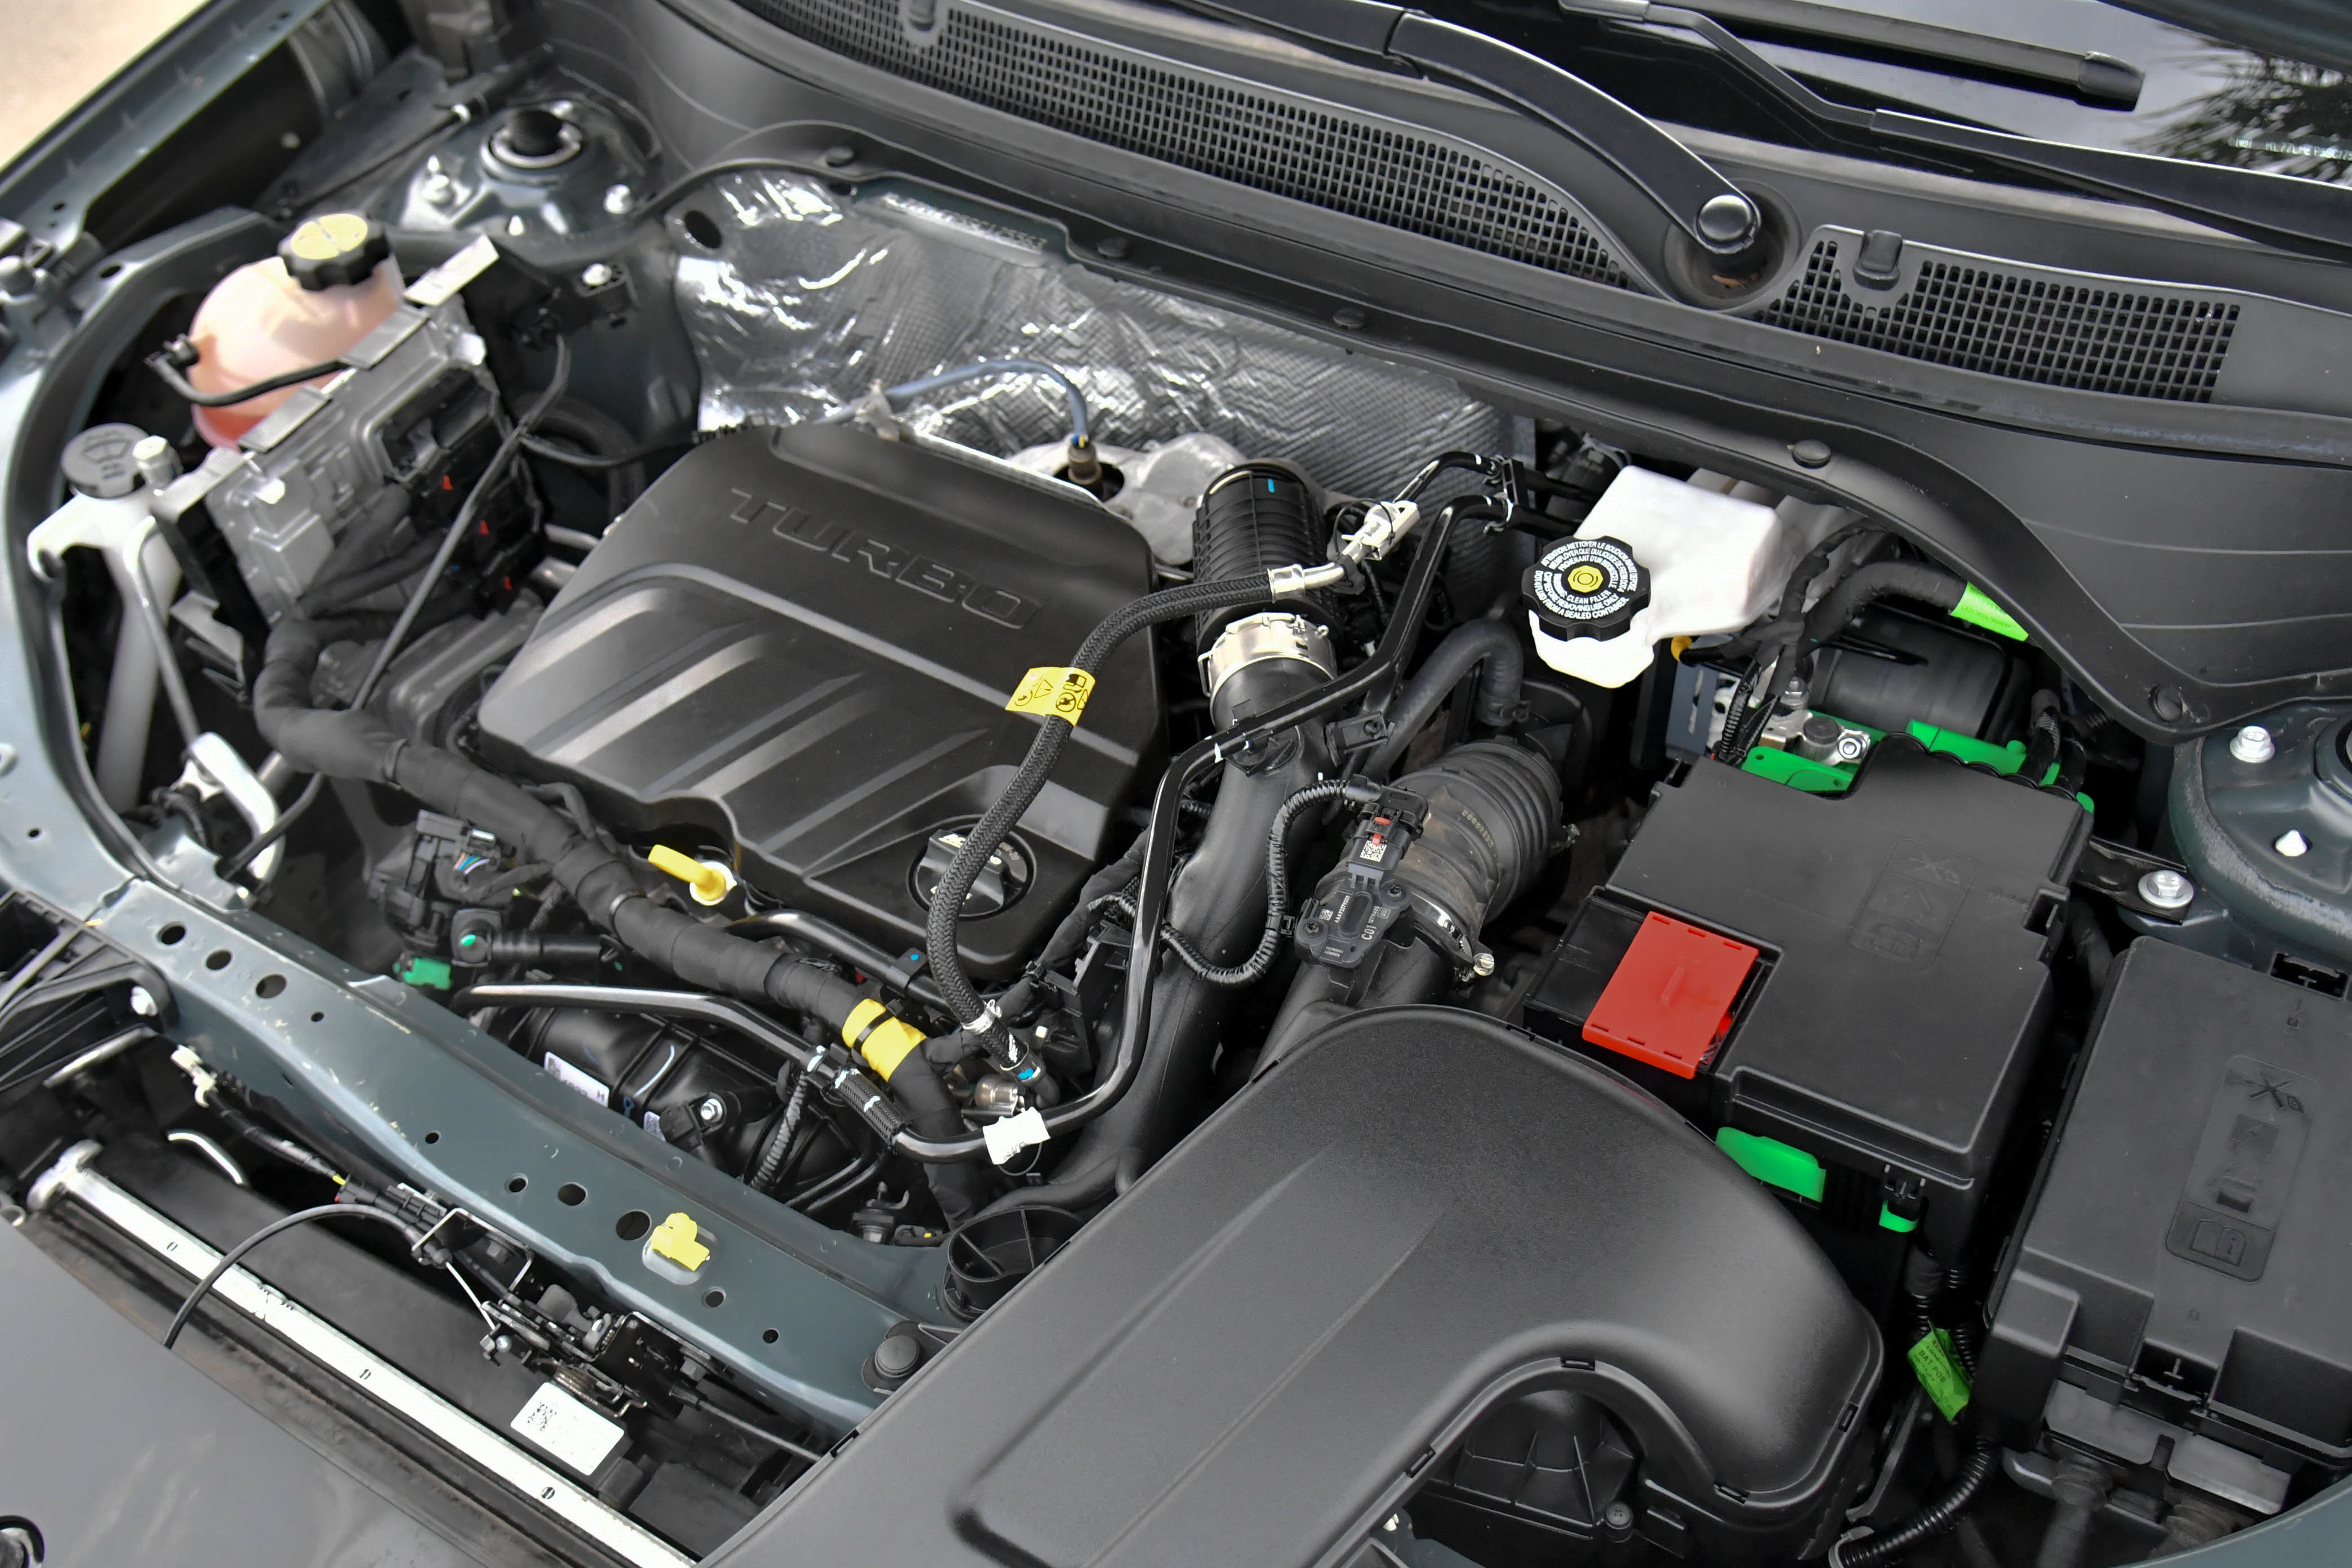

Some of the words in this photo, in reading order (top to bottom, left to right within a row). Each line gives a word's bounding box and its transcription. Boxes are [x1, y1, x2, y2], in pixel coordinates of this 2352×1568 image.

[730, 488, 1041, 630] TURBO
[1567, 595, 1588, 604] CLEAN
[1590, 590, 1611, 602] FILLER
[1543, 599, 1562, 613] FROM
[1565, 611, 1591, 619] SEALED
[1361, 925, 1377, 940] C01
[1932, 1366, 1946, 1383] POS
